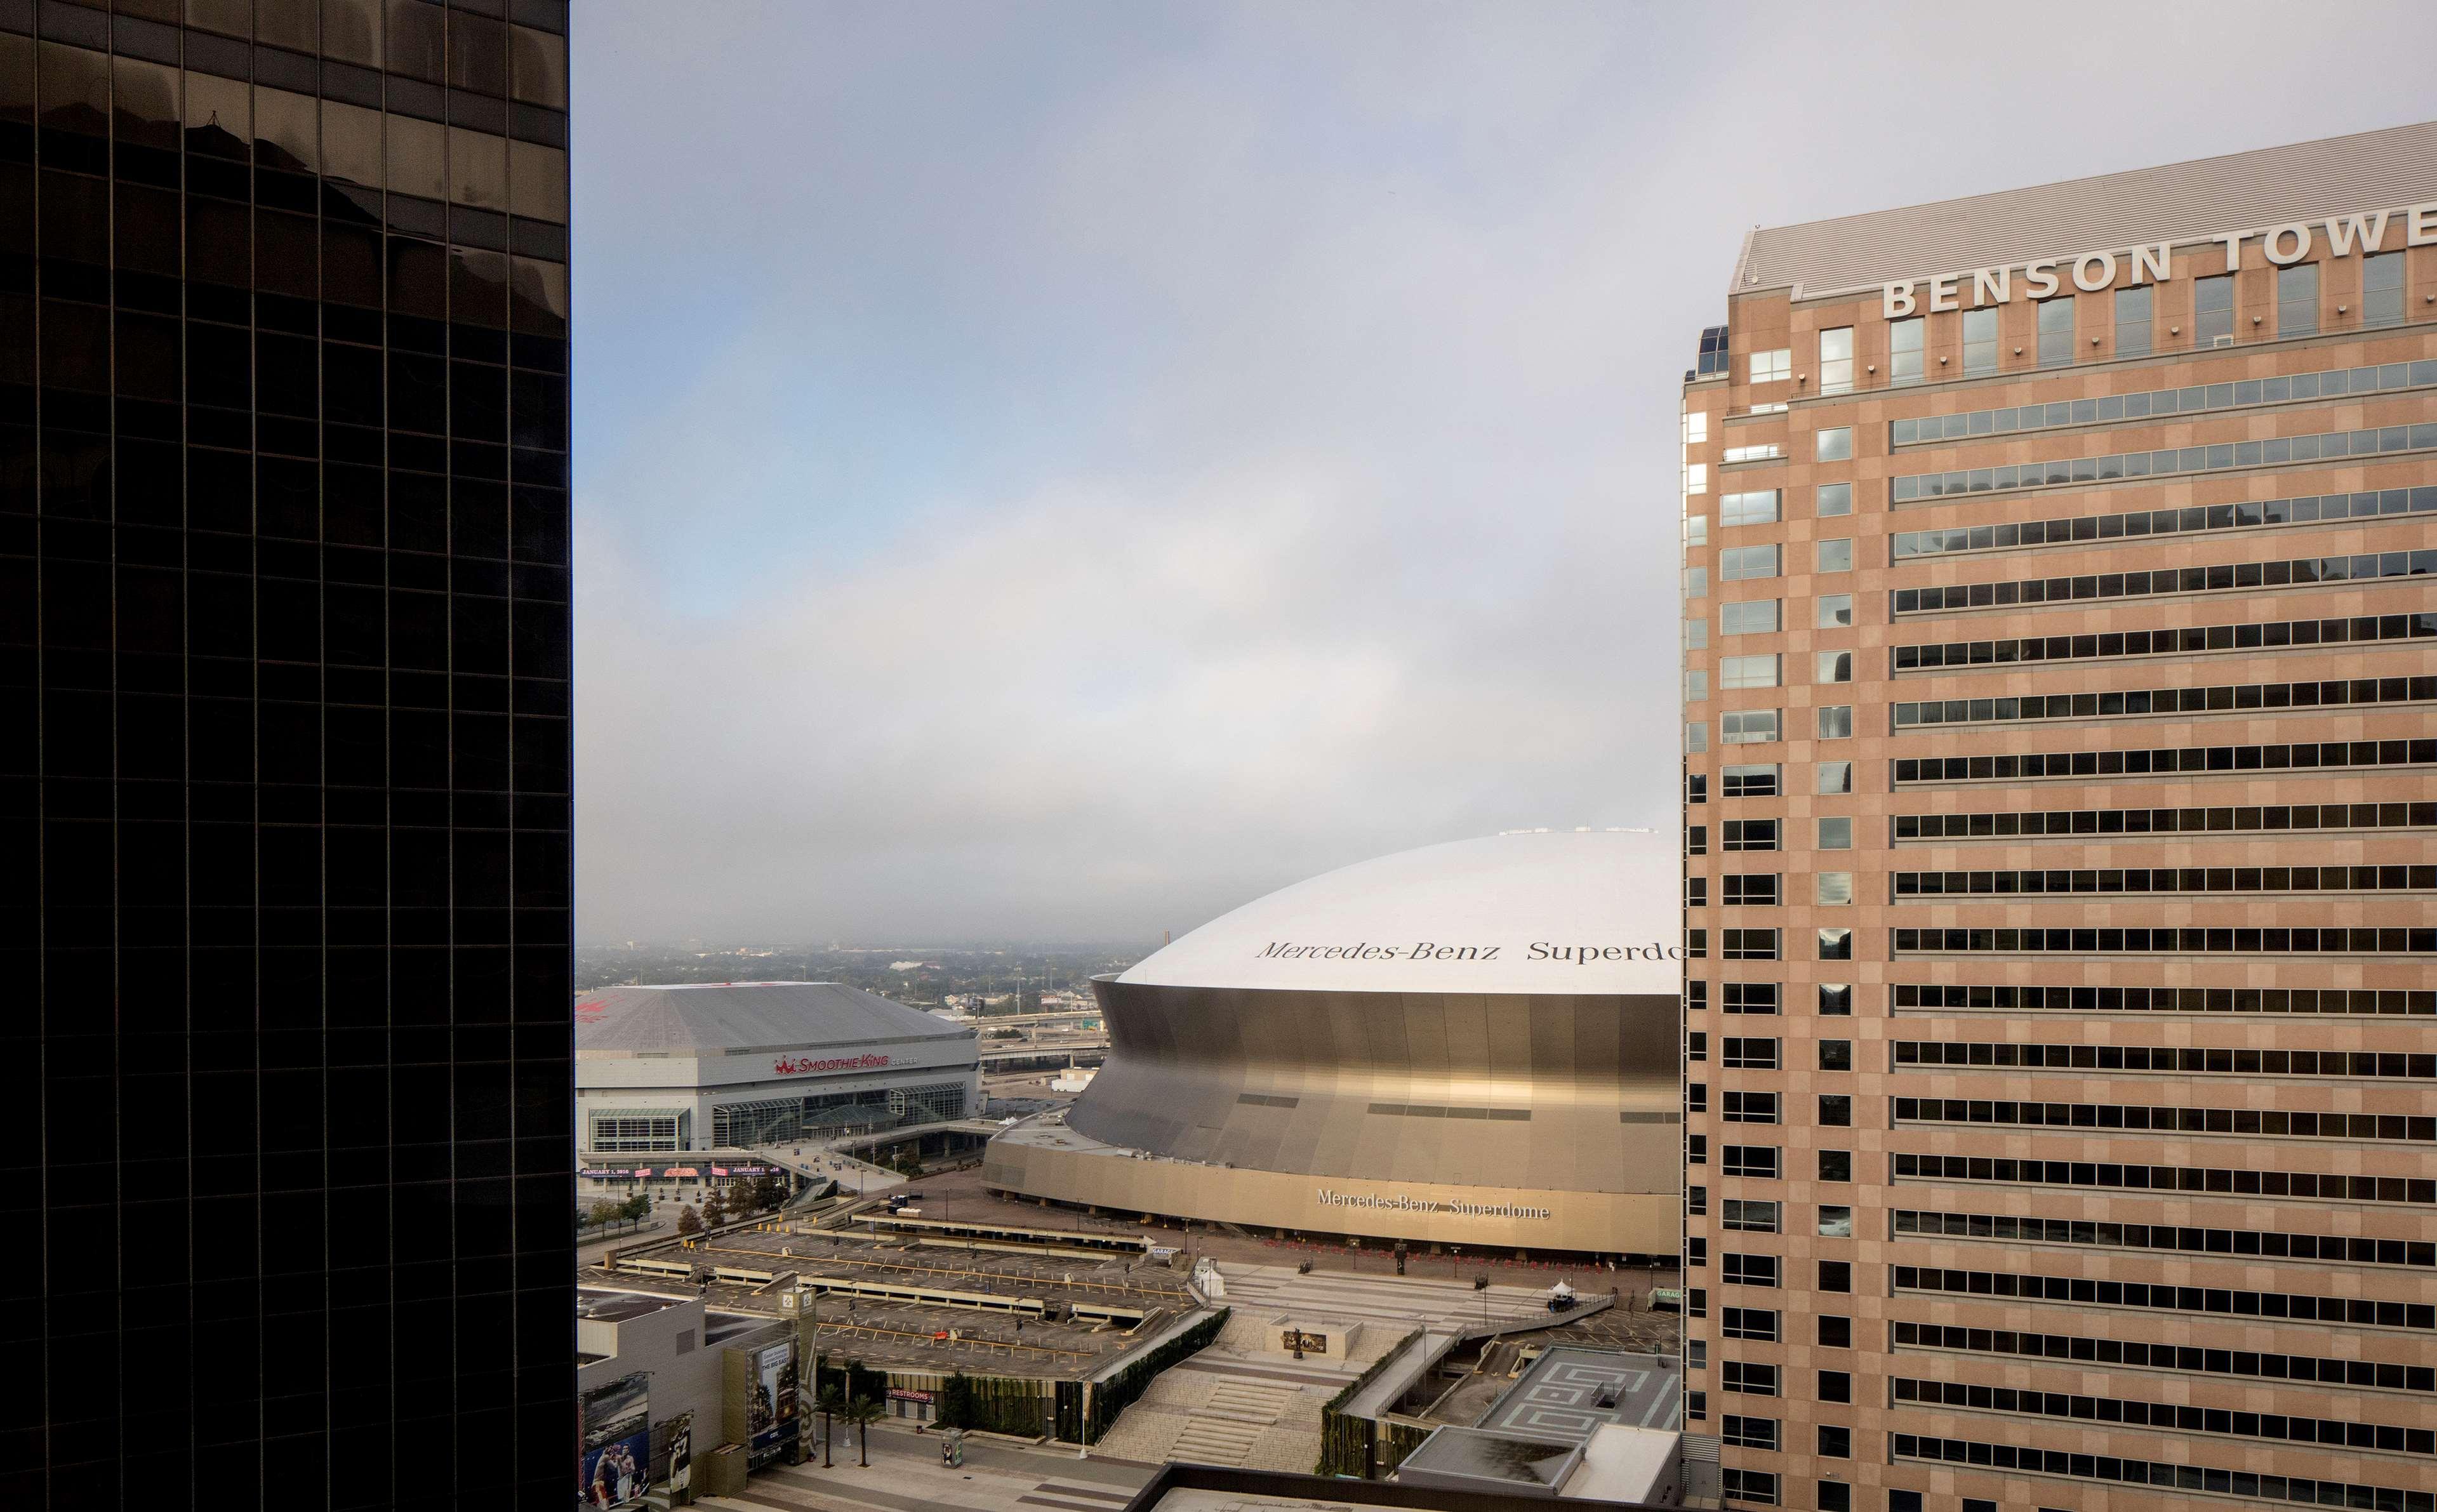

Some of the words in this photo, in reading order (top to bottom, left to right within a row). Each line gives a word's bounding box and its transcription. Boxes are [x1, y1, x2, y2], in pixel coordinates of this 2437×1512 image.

[1883, 242, 2171, 319] BENSON
[2212, 200, 2437, 272] TOWE
[1254, 941, 1501, 961] Mercedes-Benz
[799, 1057, 859, 1073] SMOOTHIE
[891, 1057, 919, 1066] CENTER
[1317, 1188, 1439, 1214] Mercedes-Benz
[1449, 1198, 1551, 1220] Superdome
[761, 1362, 771, 1371] THE
[891, 1389, 928, 1400] RESTROOMS
